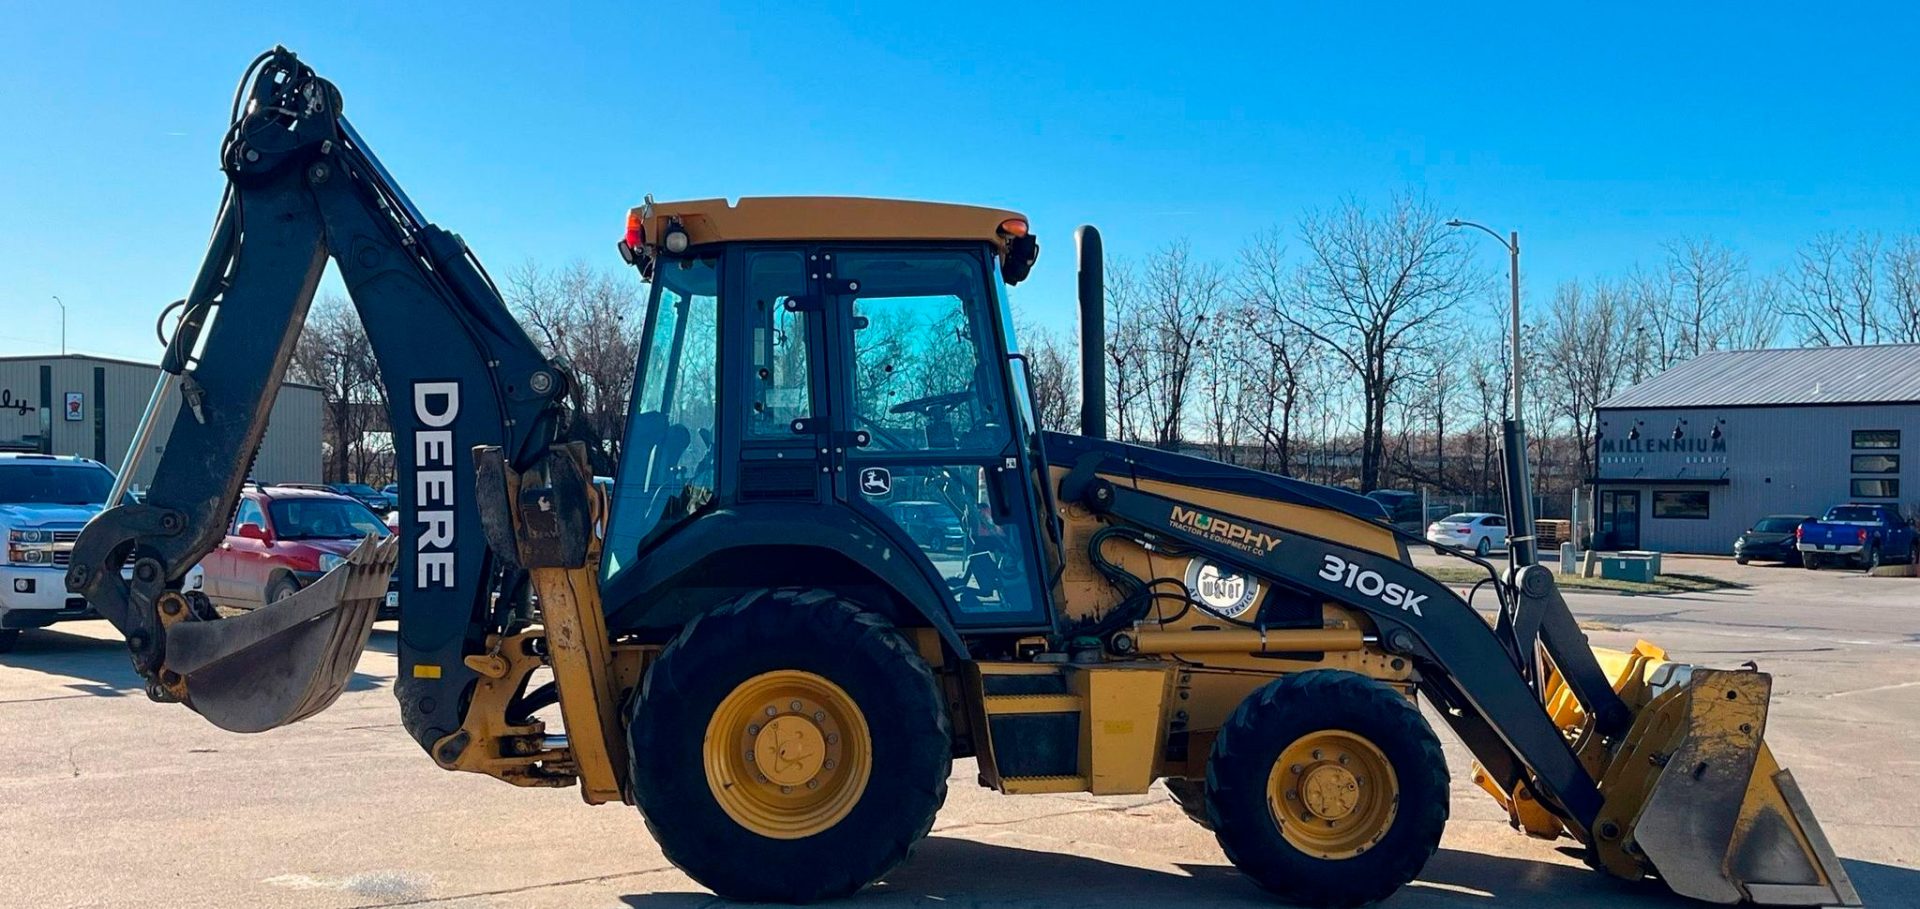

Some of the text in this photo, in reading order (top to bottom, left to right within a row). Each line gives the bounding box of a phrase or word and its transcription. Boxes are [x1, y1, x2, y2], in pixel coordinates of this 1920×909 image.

[1601, 438, 1727, 453] MILLENNIUM
[414, 382, 459, 588] DEERE
[1169, 519, 1202, 536] TRACTOR
[1210, 533, 1251, 551] EQUIPMENT
[1170, 505, 1282, 552] MURPHY
[1224, 589, 1254, 616] SERVICE
[1318, 554, 1429, 617] 310SK
